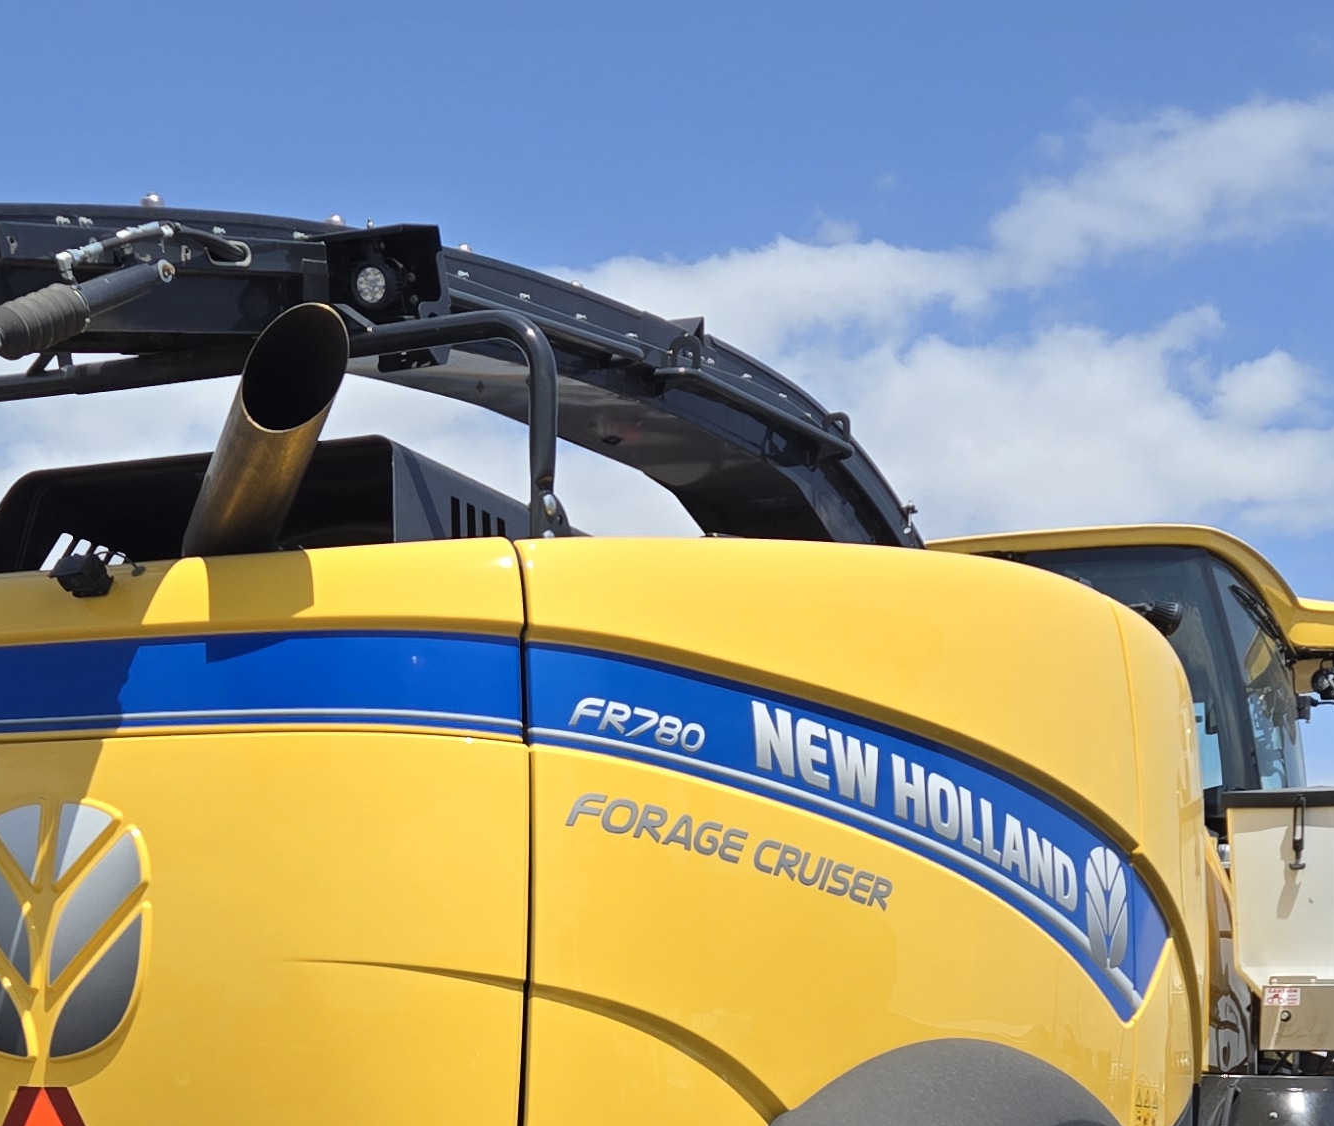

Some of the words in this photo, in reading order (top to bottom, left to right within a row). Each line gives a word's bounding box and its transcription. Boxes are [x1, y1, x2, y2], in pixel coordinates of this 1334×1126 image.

[568, 697, 706, 753] FR780
[565, 793, 749, 864] FORAGE
[753, 840, 893, 911] CRUISER
[751, 700, 879, 808] NEW
[891, 753, 1078, 912] HOLLAND
